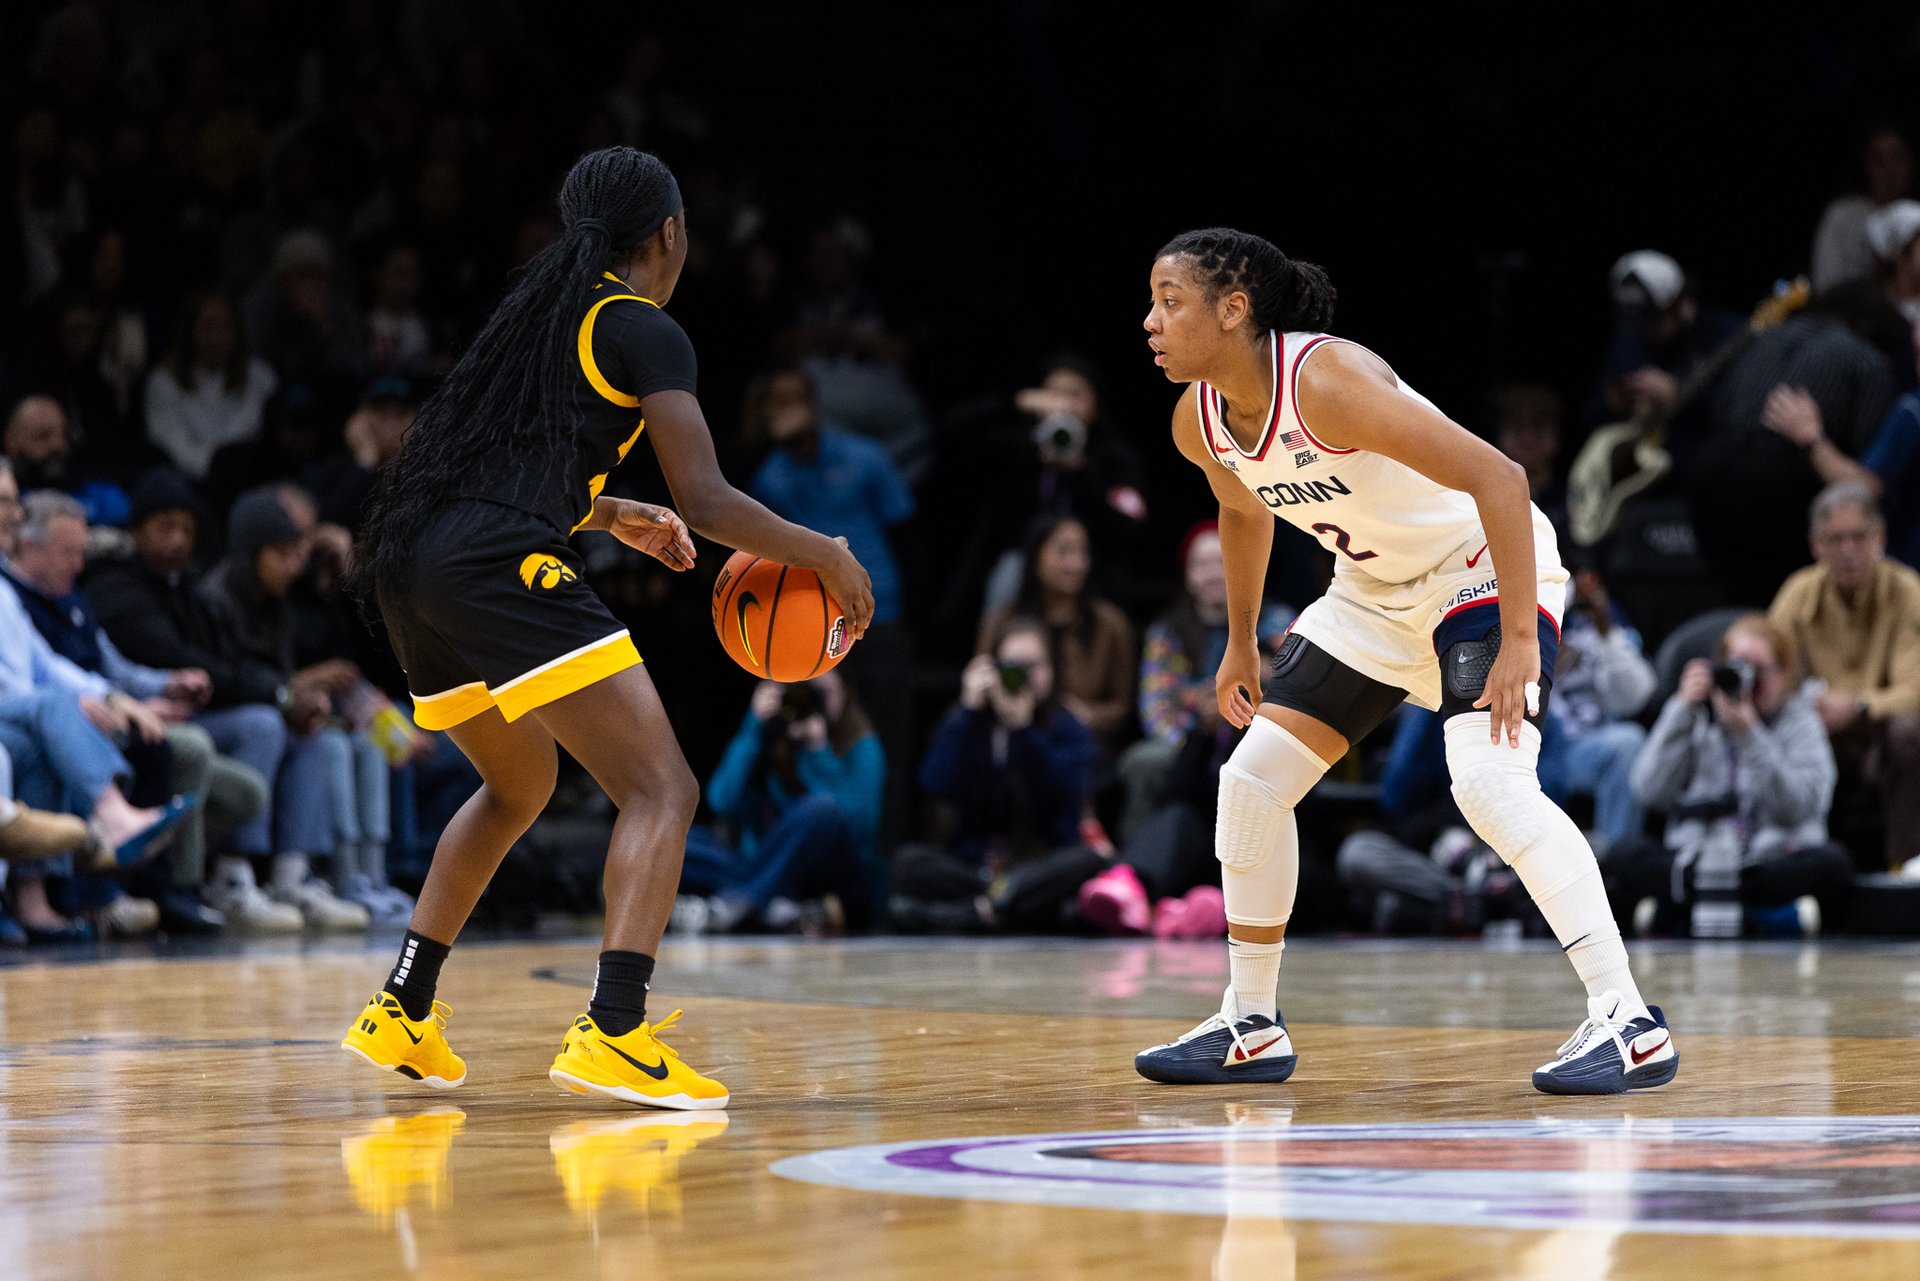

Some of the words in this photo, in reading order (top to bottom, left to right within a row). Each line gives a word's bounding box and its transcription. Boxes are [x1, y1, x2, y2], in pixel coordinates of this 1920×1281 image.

[1294, 450, 1311, 460] BIG
[1295, 453, 1319, 466] EAST
[1251, 475, 1352, 508] CONN
[1311, 522, 1379, 561] 2
[1438, 579, 1498, 613] SKIE
